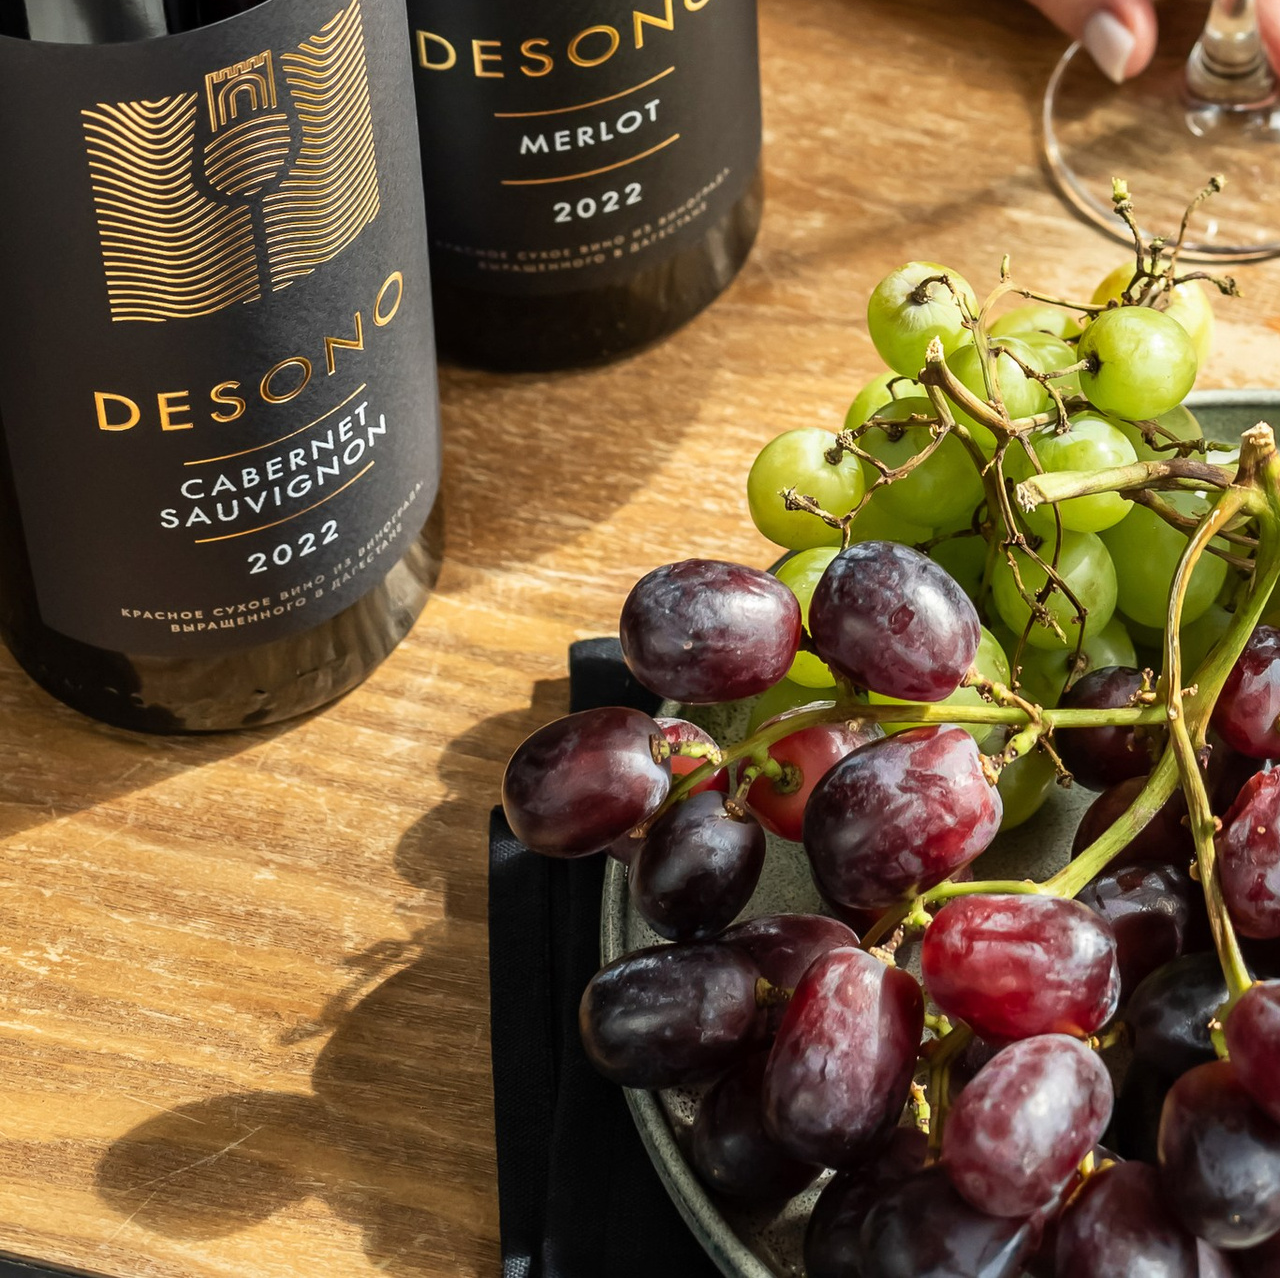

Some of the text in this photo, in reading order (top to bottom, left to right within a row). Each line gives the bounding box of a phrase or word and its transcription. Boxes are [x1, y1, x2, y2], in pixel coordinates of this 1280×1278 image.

[519, 98, 661, 155] MERLOT
[552, 182, 643, 224] 2022
[93, 270, 404, 432] DESONO
[159, 413, 388, 529] SAUVIGNON
[180, 400, 369, 500] CABERNET
[247, 519, 340, 575] 2022
[120, 607, 204, 620] КРАСНОЕ
[212, 596, 271, 618] СУХОЕ
[279, 574, 325, 601] ВИНО
[170, 597, 307, 633] ВЫРАЩЕННОГО
